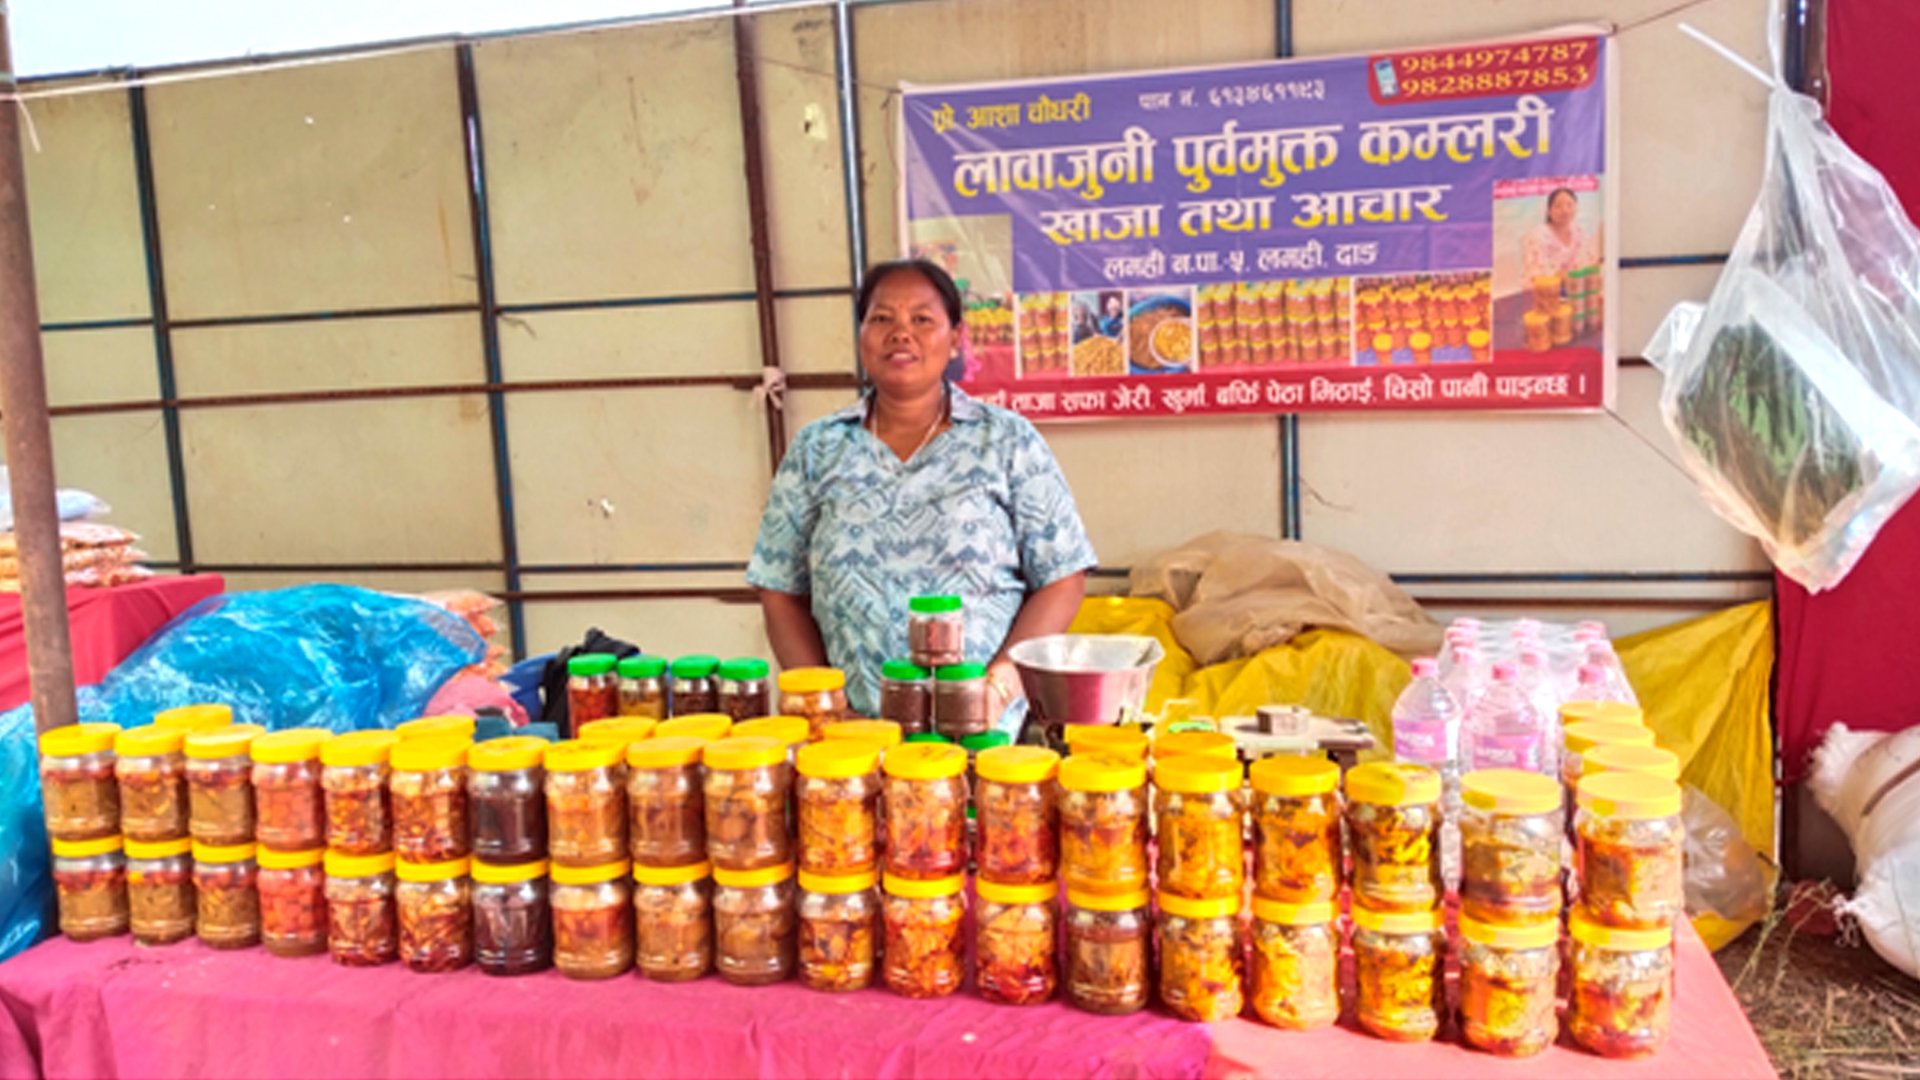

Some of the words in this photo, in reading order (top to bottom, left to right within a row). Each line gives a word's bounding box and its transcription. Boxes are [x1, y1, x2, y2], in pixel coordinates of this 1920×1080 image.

[1401, 41, 1588, 74] 9844974787
[1401, 64, 1589, 98] 9828887853
[966, 103, 1021, 130] आशा
[1027, 92, 1092, 123] चौधरी
[953, 126, 1157, 200] लावाजुनी
[1172, 119, 1344, 193] पुर्वमुक्त
[1359, 94, 1555, 165] कम्लरी
[1040, 204, 1163, 246] खाजा
[1179, 196, 1276, 237] तथा
[1291, 184, 1453, 229] आचार
[1103, 248, 1166, 280] लमही
[1012, 392, 1056, 413] ताजा
[1061, 388, 1106, 413] सफा
[1266, 379, 1303, 406] पेठा
[1384, 373, 1434, 400] चिसो
[1440, 371, 1489, 399] पानी
[1496, 374, 1571, 399] पाइन्छ
